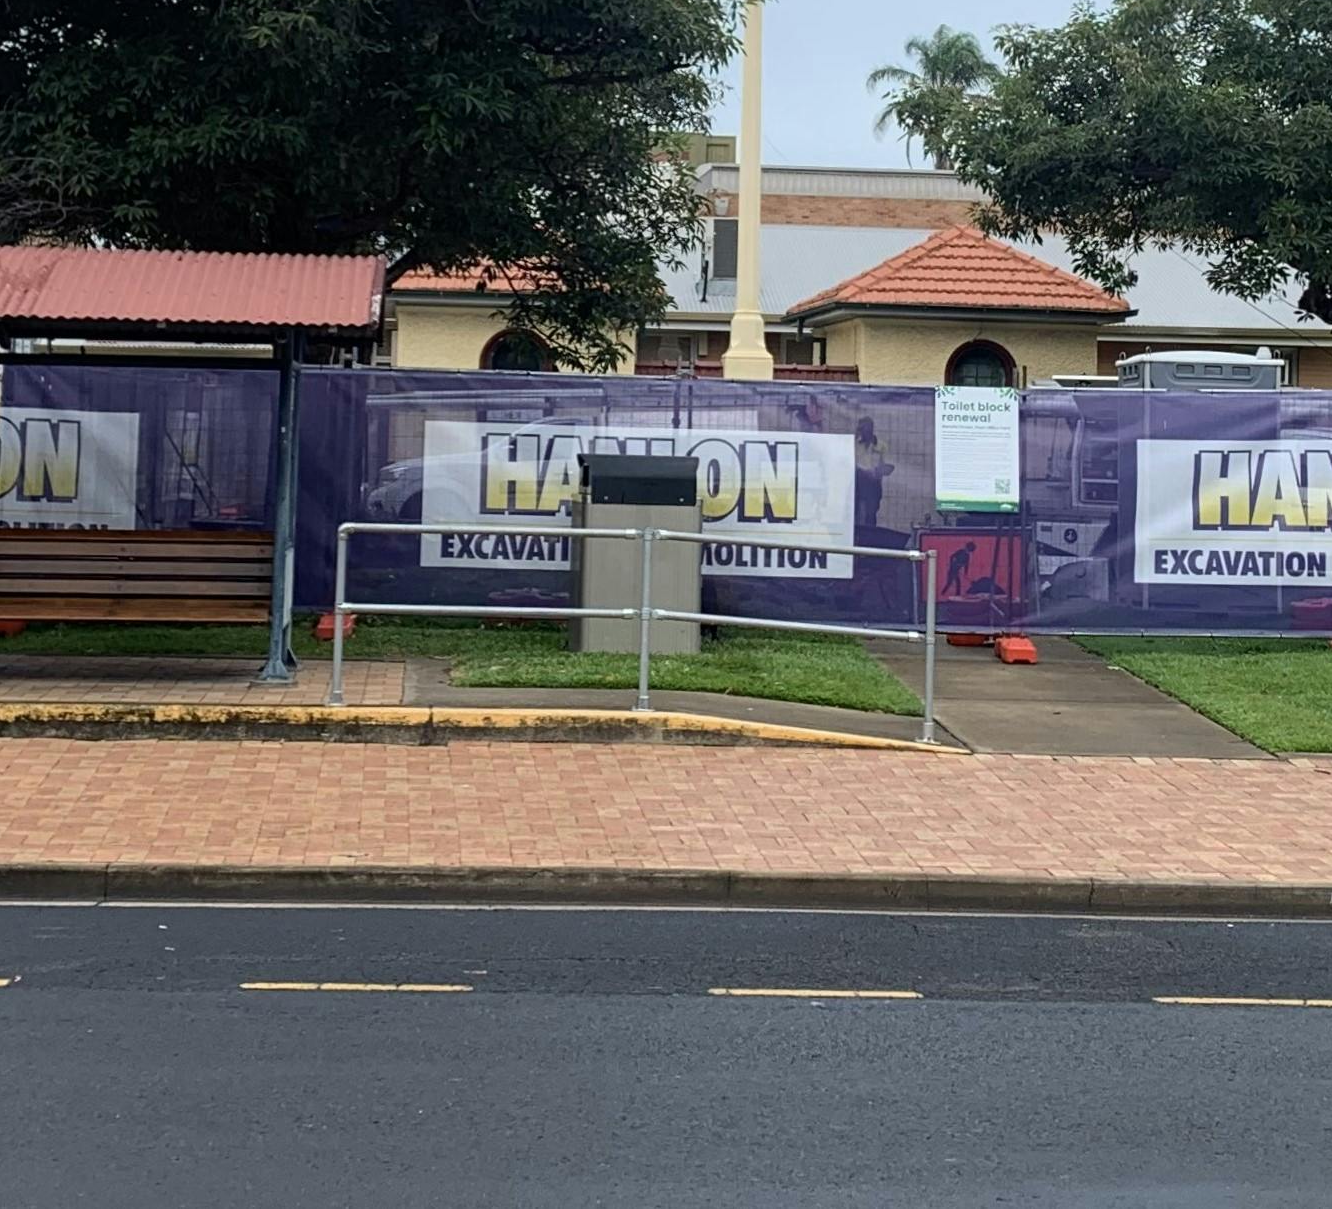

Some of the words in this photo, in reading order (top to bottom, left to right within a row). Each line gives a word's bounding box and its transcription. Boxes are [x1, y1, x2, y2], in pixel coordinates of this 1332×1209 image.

[941, 401, 975, 411] Toilet
[978, 402, 1011, 412] block
[941, 413, 991, 423] renewal
[480, 432, 799, 523] HAON
[441, 532, 571, 562] EXCAVATI
[702, 543, 828, 569] OLITION
[1154, 550, 1327, 578] EXCAVATION
